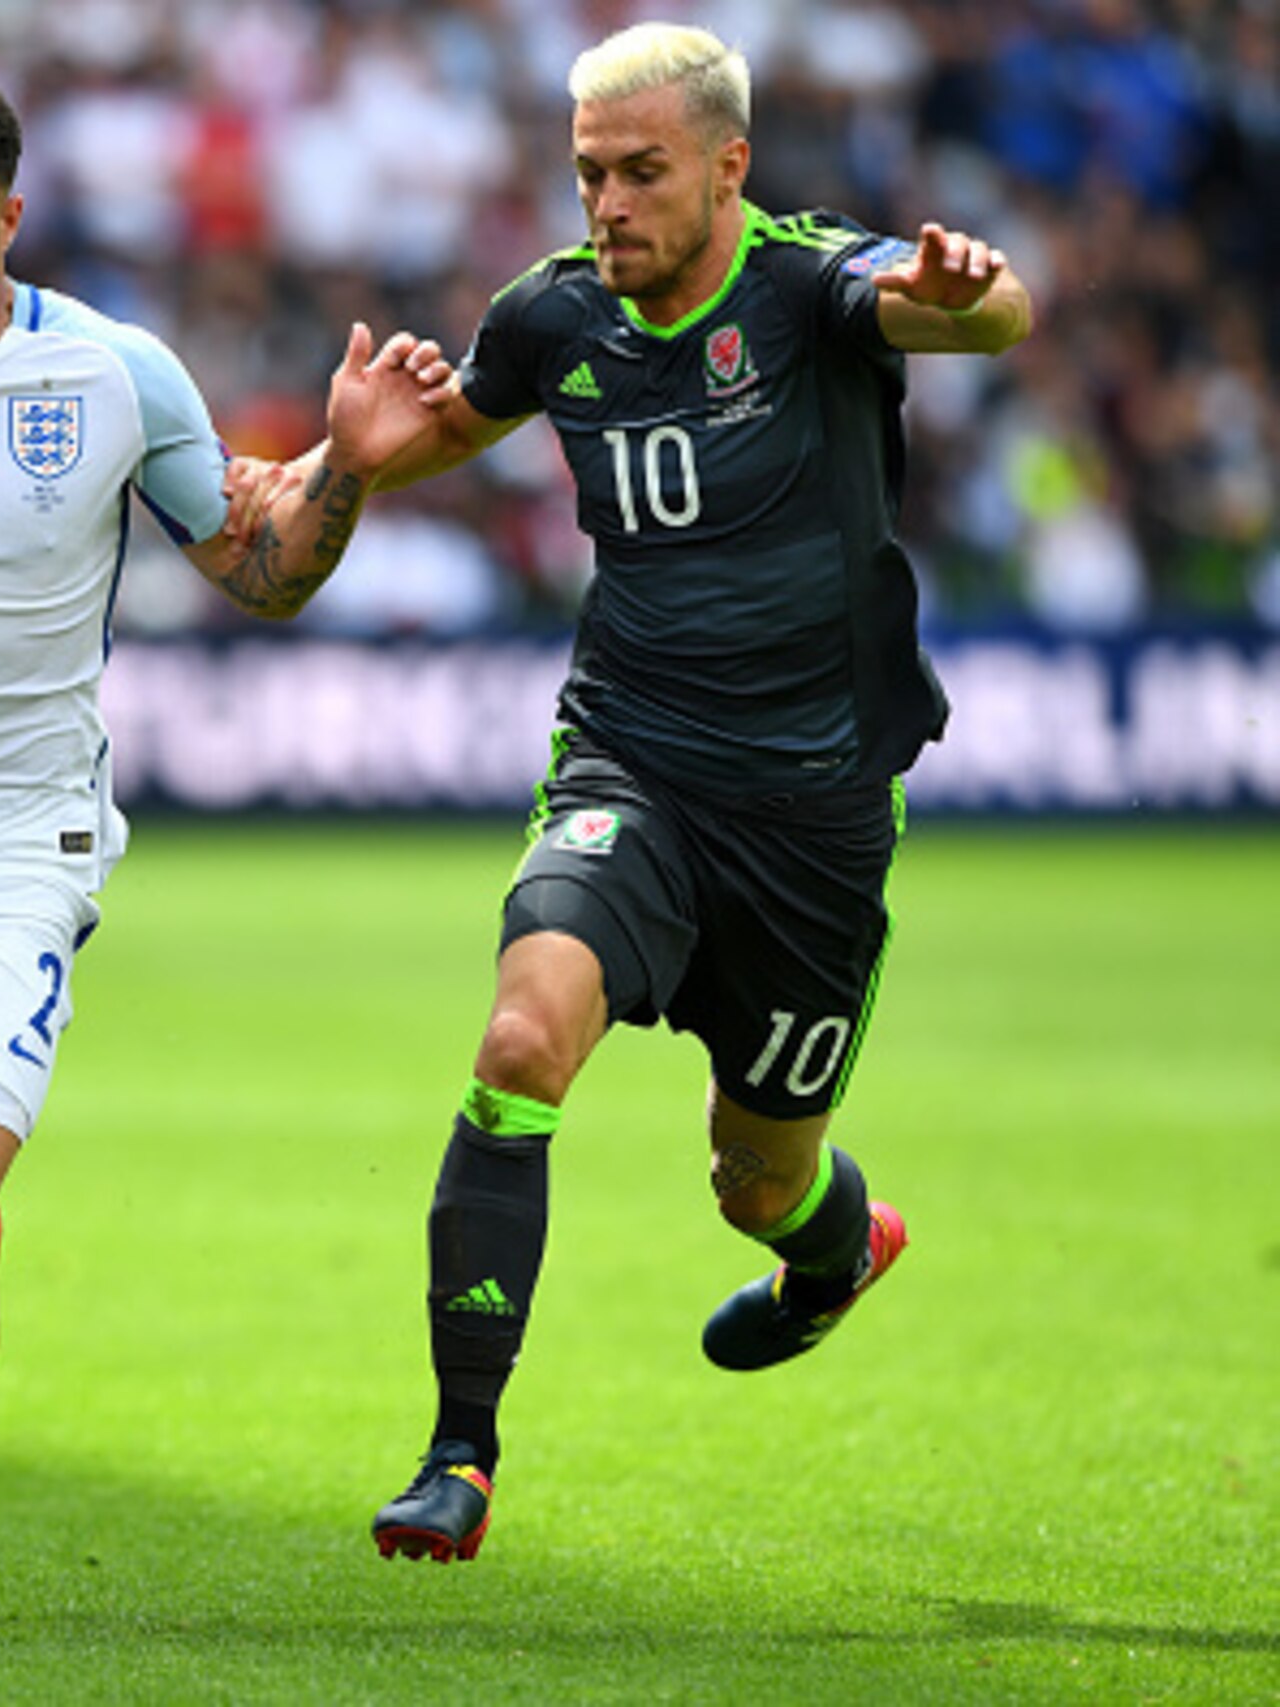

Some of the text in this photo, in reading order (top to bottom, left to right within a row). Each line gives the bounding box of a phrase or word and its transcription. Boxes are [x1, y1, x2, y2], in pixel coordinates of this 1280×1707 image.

[602, 425, 701, 533] 10
[28, 951, 63, 1048] 2
[745, 1010, 850, 1096] 10
